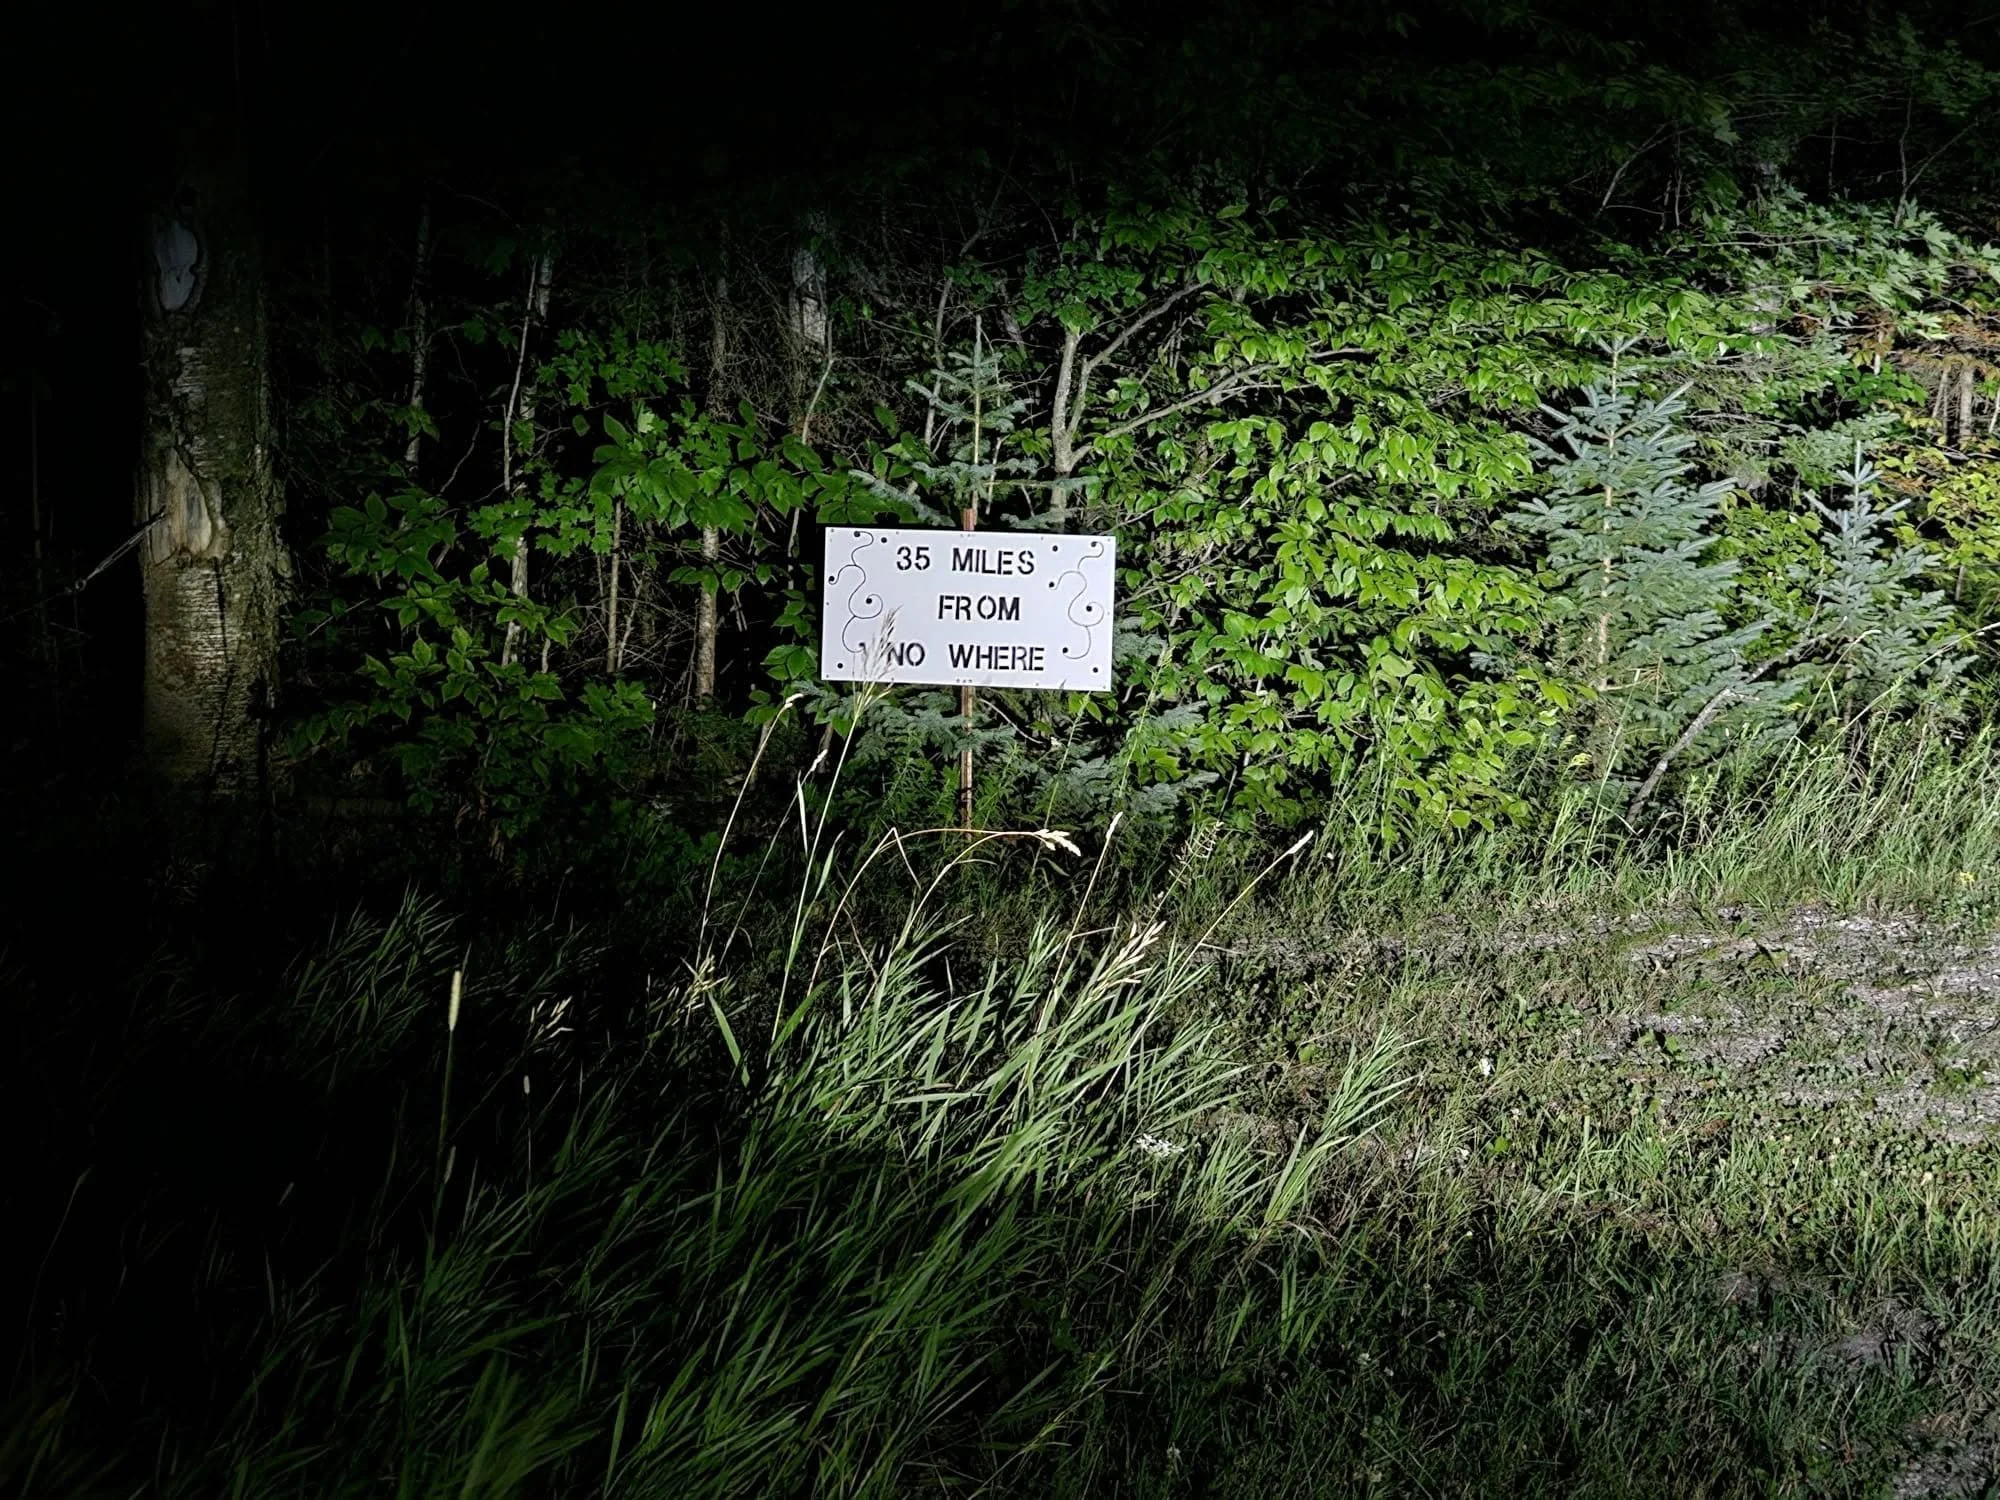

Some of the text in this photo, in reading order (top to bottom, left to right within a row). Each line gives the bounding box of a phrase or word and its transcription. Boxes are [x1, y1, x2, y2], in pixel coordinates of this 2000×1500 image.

[896, 546, 1035, 575] 35 MILES
[938, 594, 1020, 621] FROM
[884, 641, 1045, 672] NO WHERE
